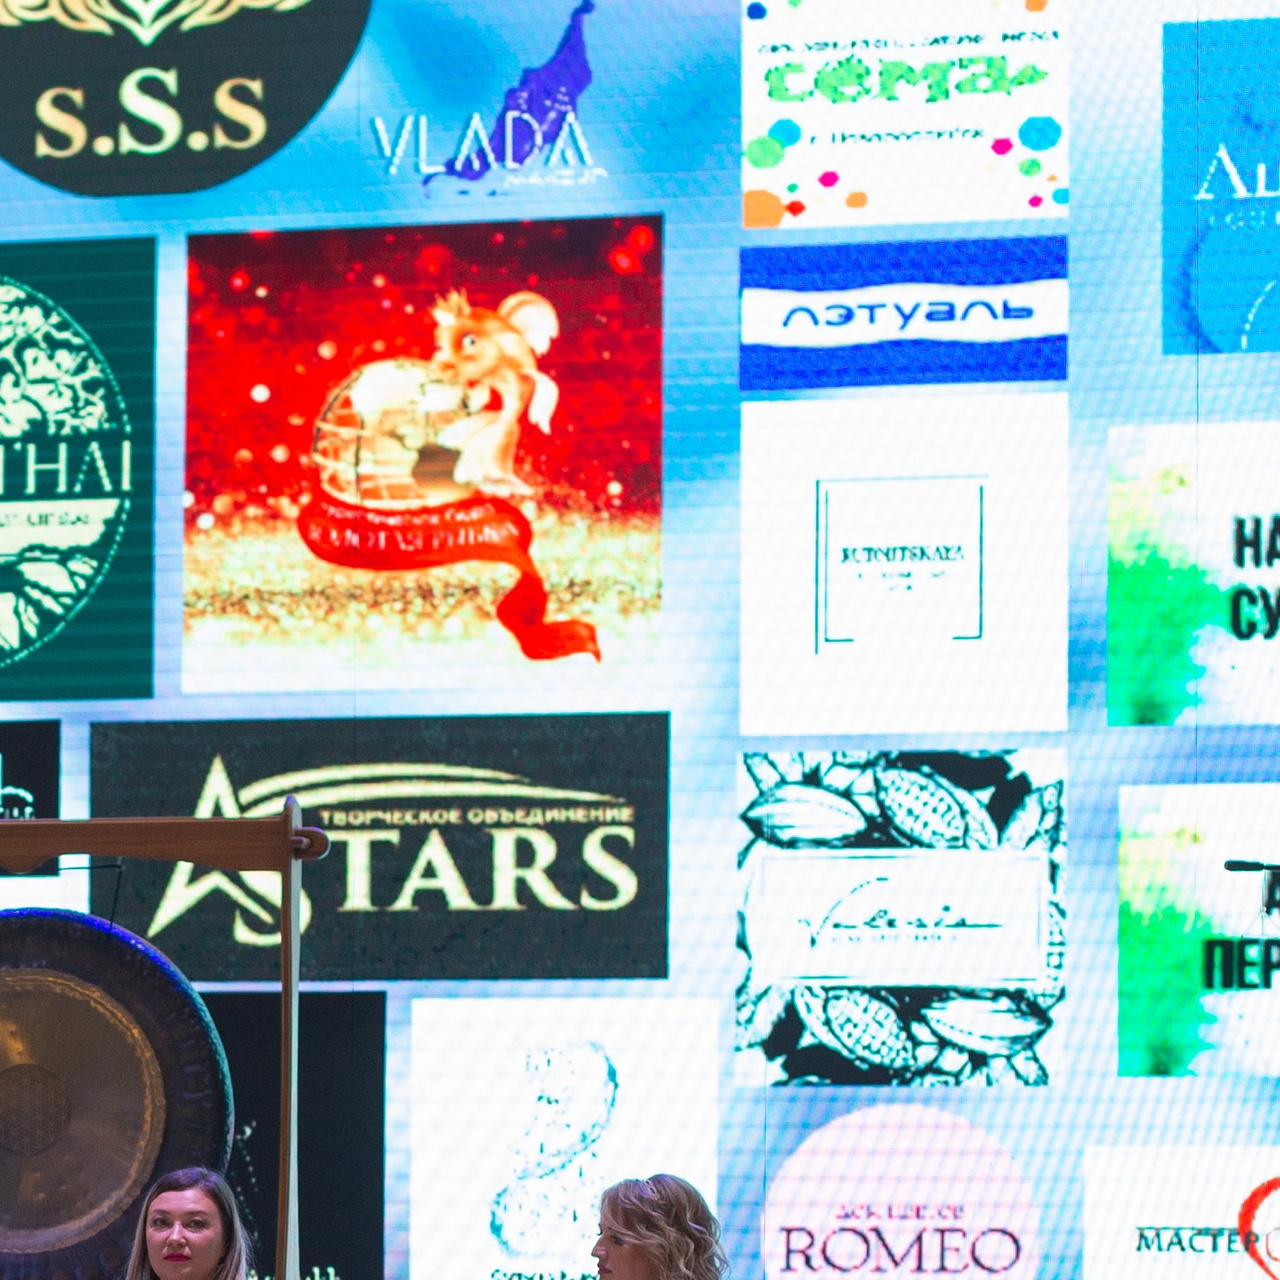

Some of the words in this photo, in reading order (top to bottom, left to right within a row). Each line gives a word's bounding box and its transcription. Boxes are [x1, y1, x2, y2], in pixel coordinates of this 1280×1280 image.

[35, 67, 267, 158] S.S.S
[372, 110, 594, 175] VLADA
[320, 808, 462, 826] ТВОРЧЕСКОЕ
[467, 806, 635, 826] ОБЪЕДИНЕНИЕ
[779, 1226, 1022, 1274] ROMEO
